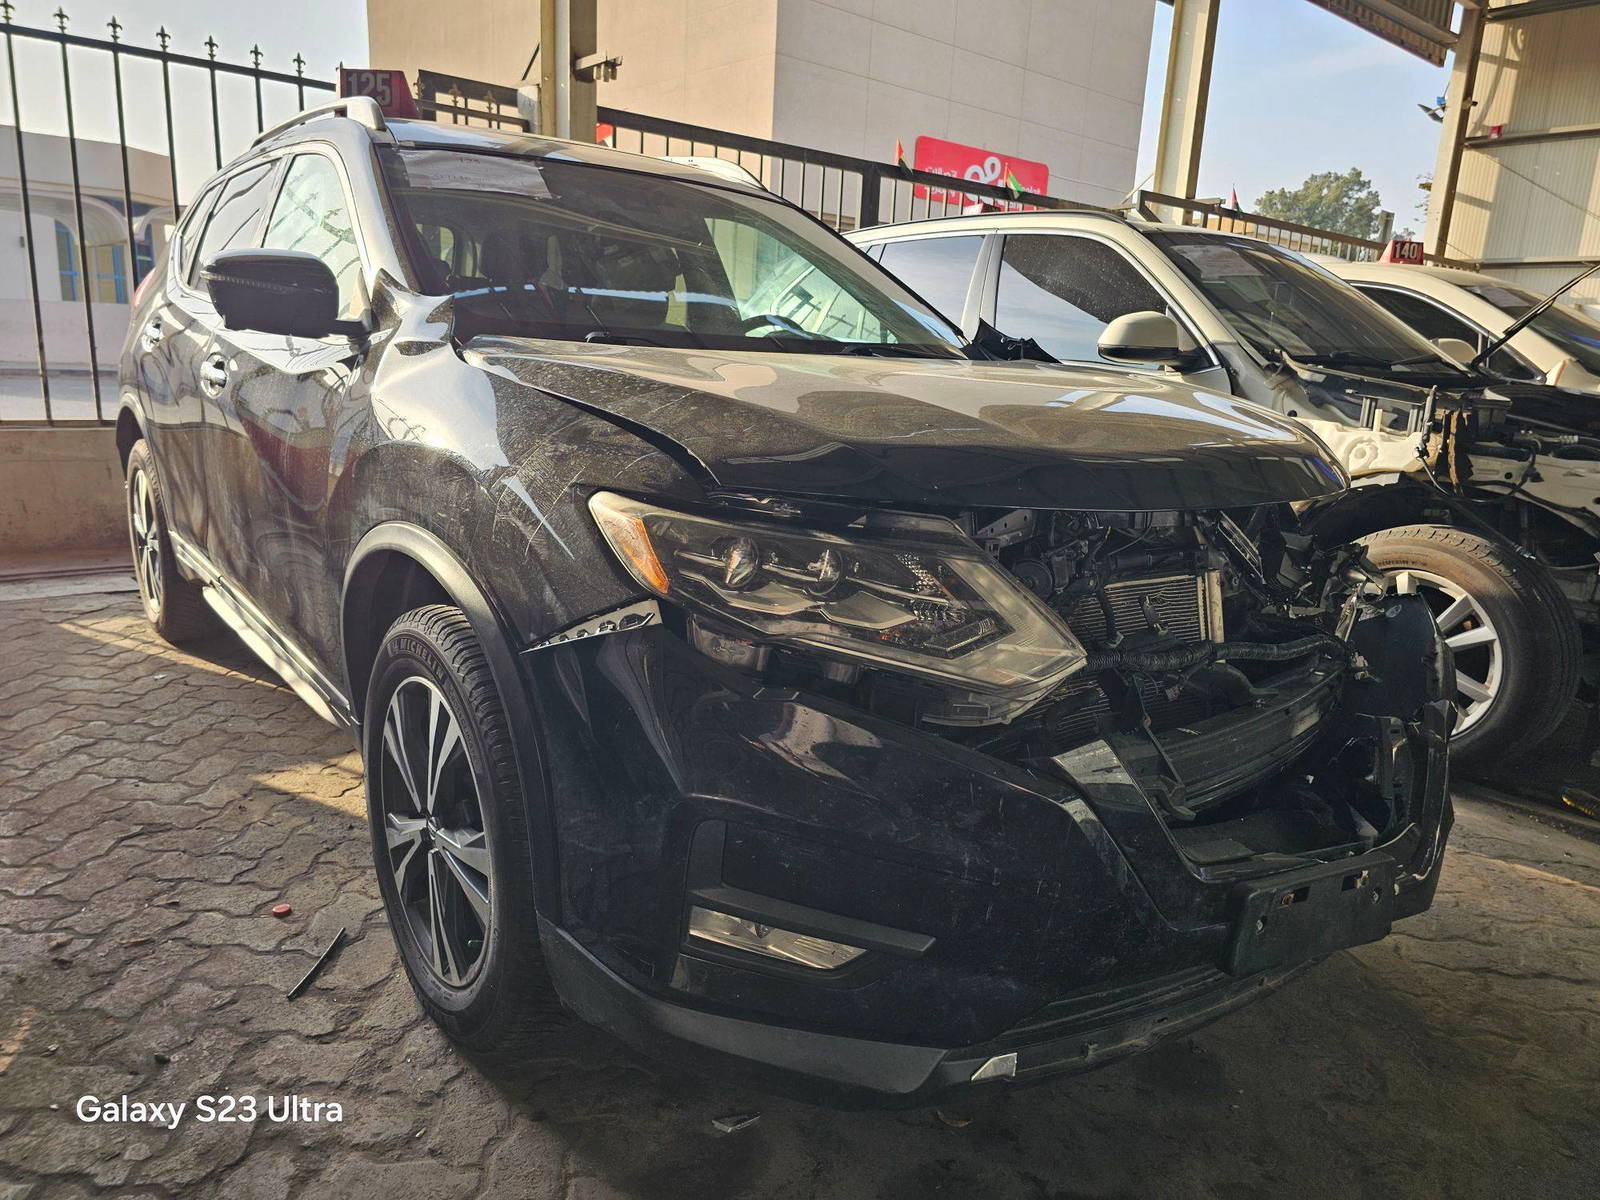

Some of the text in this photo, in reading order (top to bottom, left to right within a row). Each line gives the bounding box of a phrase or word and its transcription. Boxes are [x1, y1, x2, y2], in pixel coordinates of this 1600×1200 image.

[348, 72, 391, 106] 125
[1395, 242, 1418, 259] 140
[400, 637, 446, 682] MICHELIN
